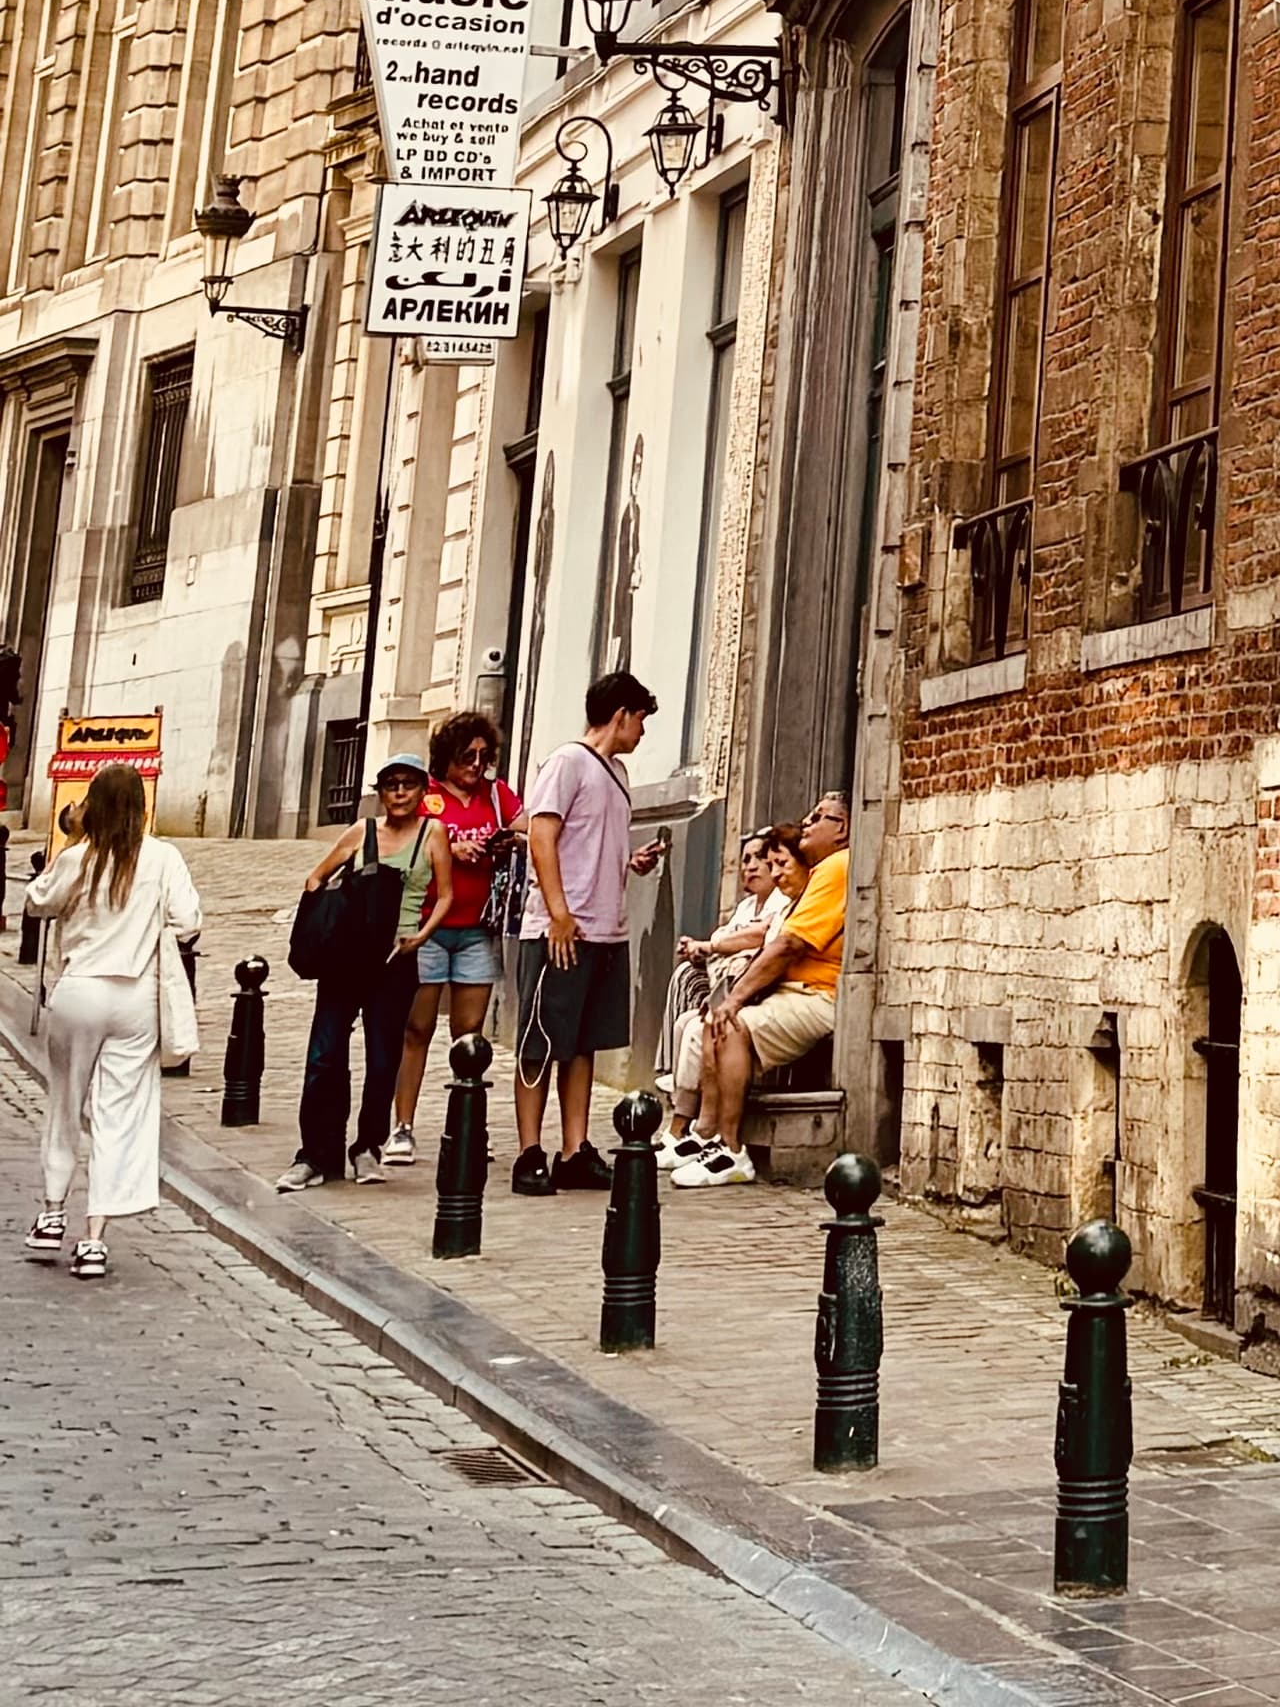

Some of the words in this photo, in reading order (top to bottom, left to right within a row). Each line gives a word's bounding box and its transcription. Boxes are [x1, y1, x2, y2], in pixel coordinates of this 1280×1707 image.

[376, 6, 525, 35] d'occasion
[376, 37, 428, 49] records
[414, 60, 481, 88] hand
[417, 93, 518, 115] records
[402, 116, 445, 131] Achat
[450, 121, 465, 131] et
[470, 123, 510, 134] vente
[396, 131, 418, 141] we
[422, 131, 449, 146] buy
[454, 133, 464, 145] &
[470, 134, 496, 146] sell
[396, 147, 418, 161] LP
[454, 151, 492, 165] CD's
[400, 165, 413, 180] &
[421, 166, 497, 182] IMPORT
[382, 297, 510, 326] АРЛЕКИН
